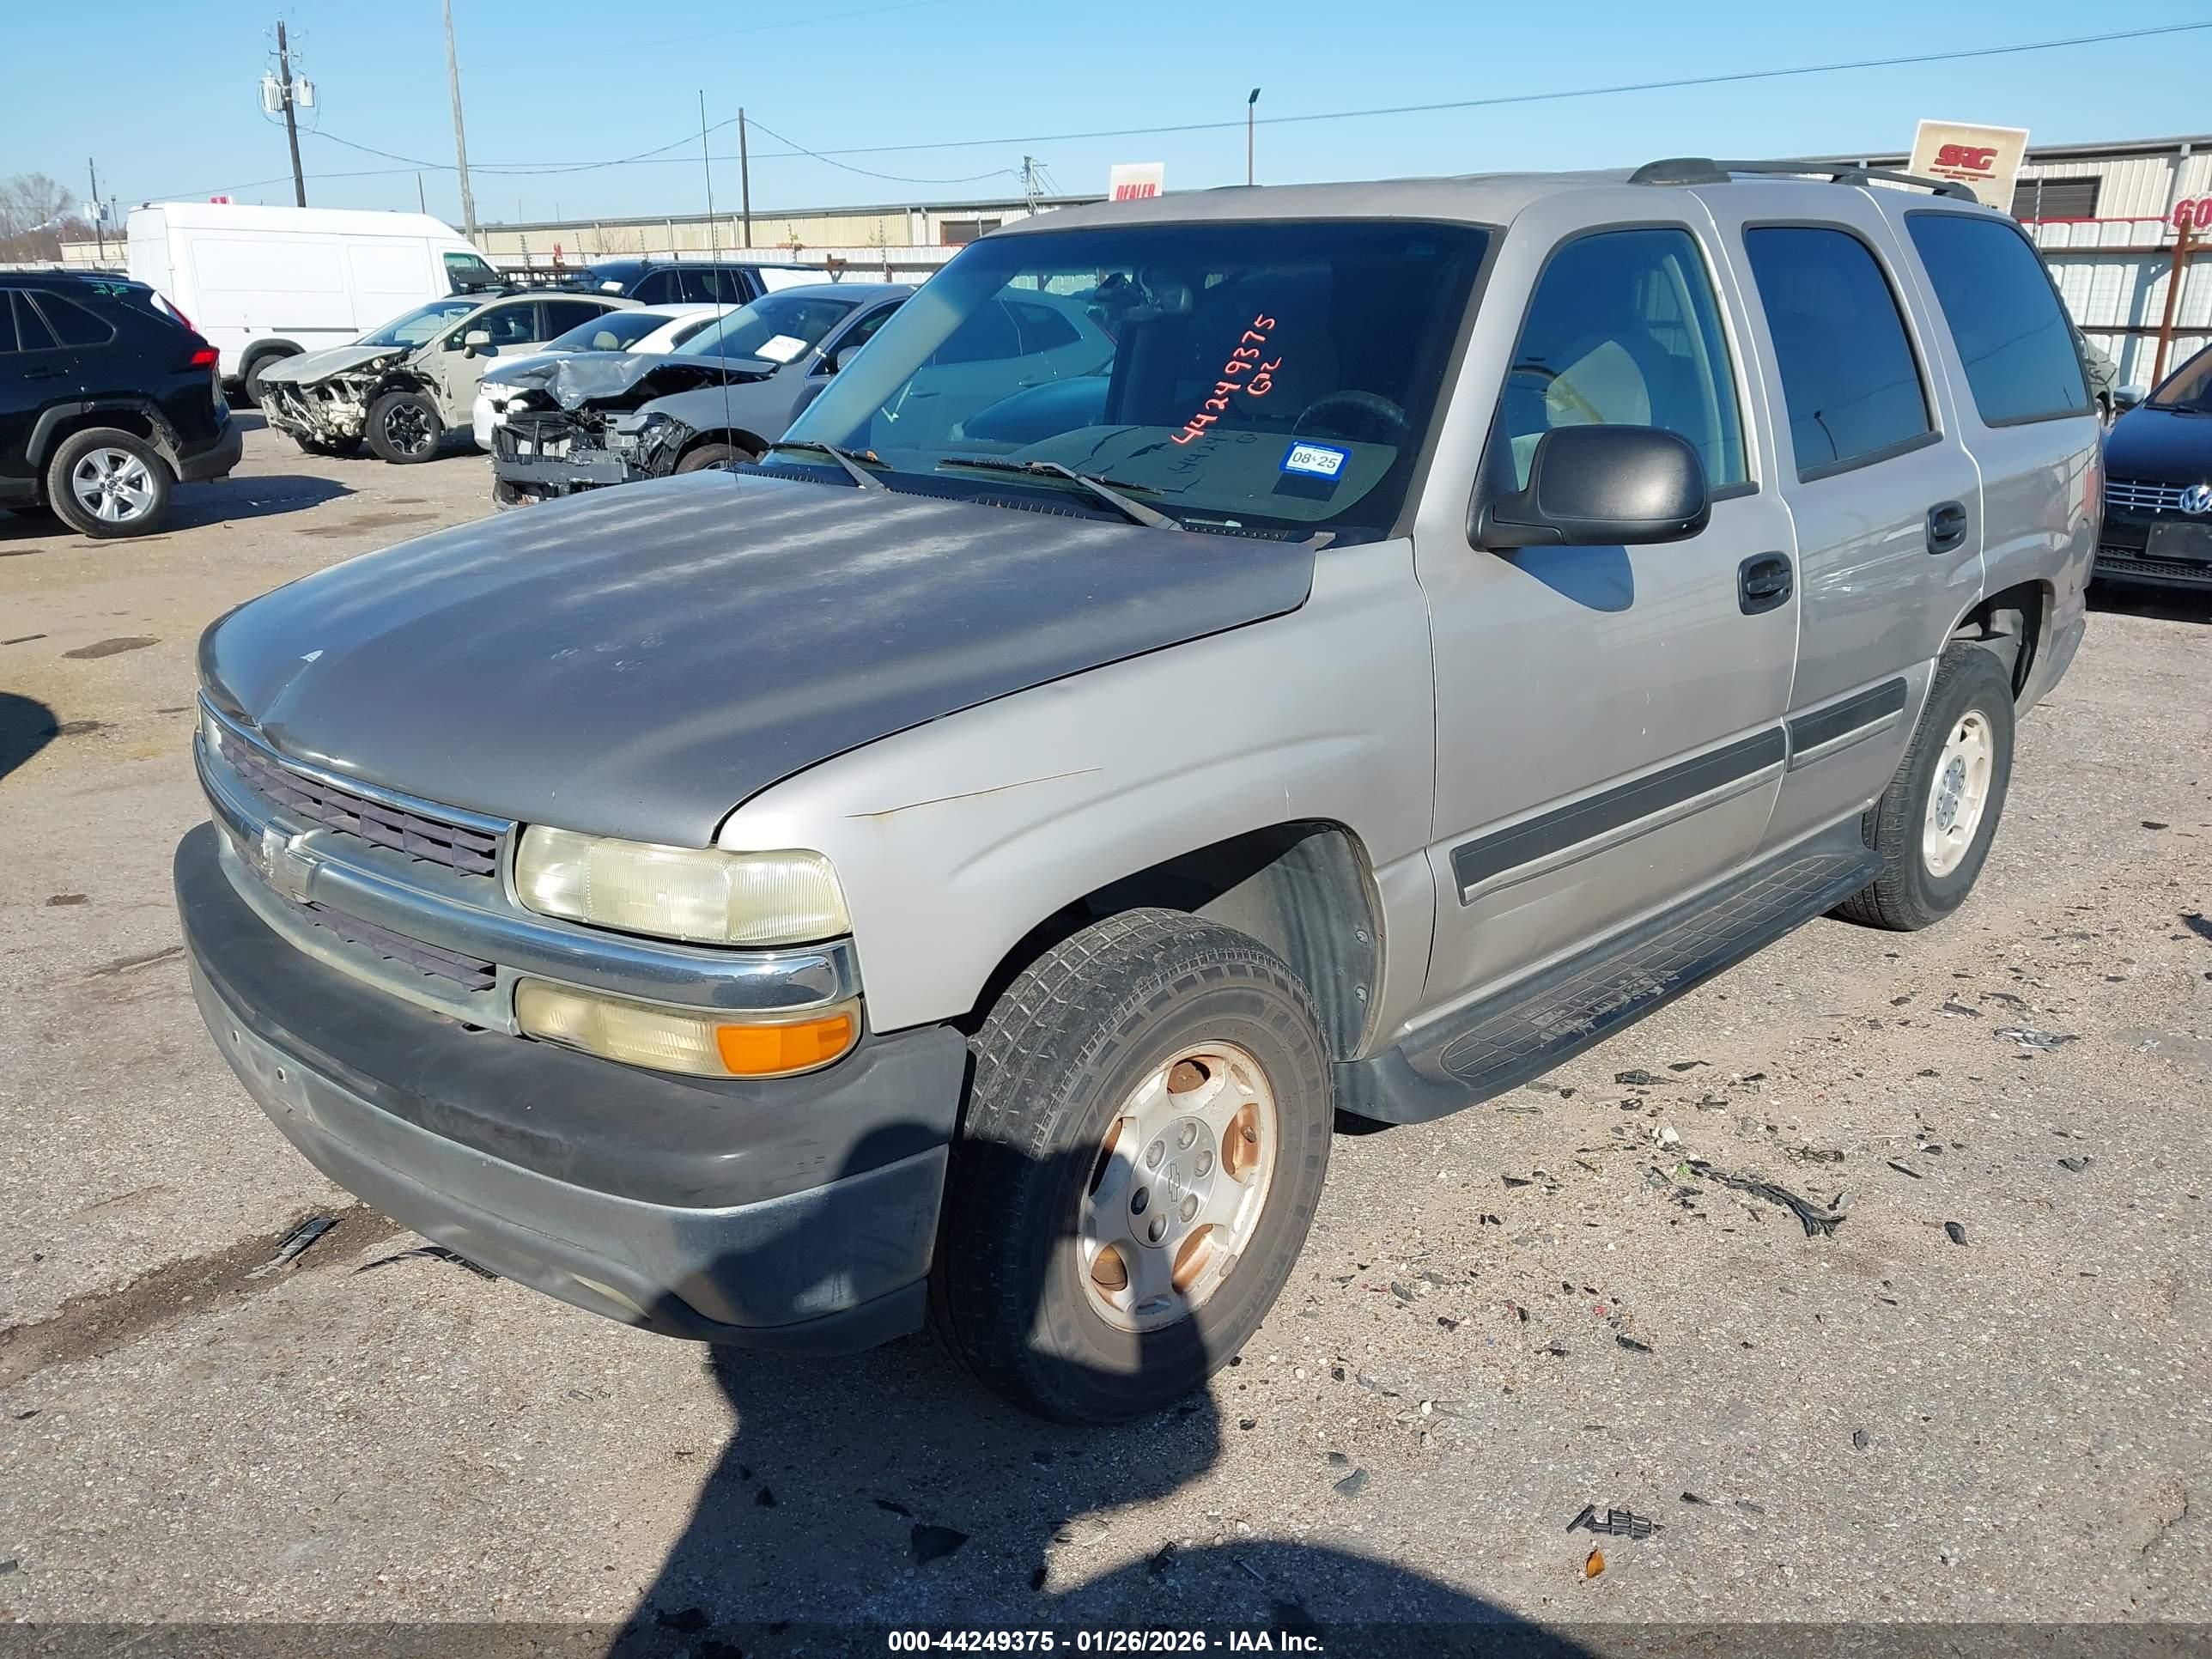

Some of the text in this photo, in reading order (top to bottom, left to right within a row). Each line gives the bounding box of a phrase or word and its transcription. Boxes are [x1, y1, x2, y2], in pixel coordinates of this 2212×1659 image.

[1934, 144, 1999, 170] SRG
[1116, 183, 1156, 200] DEALER
[1170, 313, 1276, 444] 44249375
[1291, 452, 1312, 464] 08
[1317, 456, 1339, 469] 25
